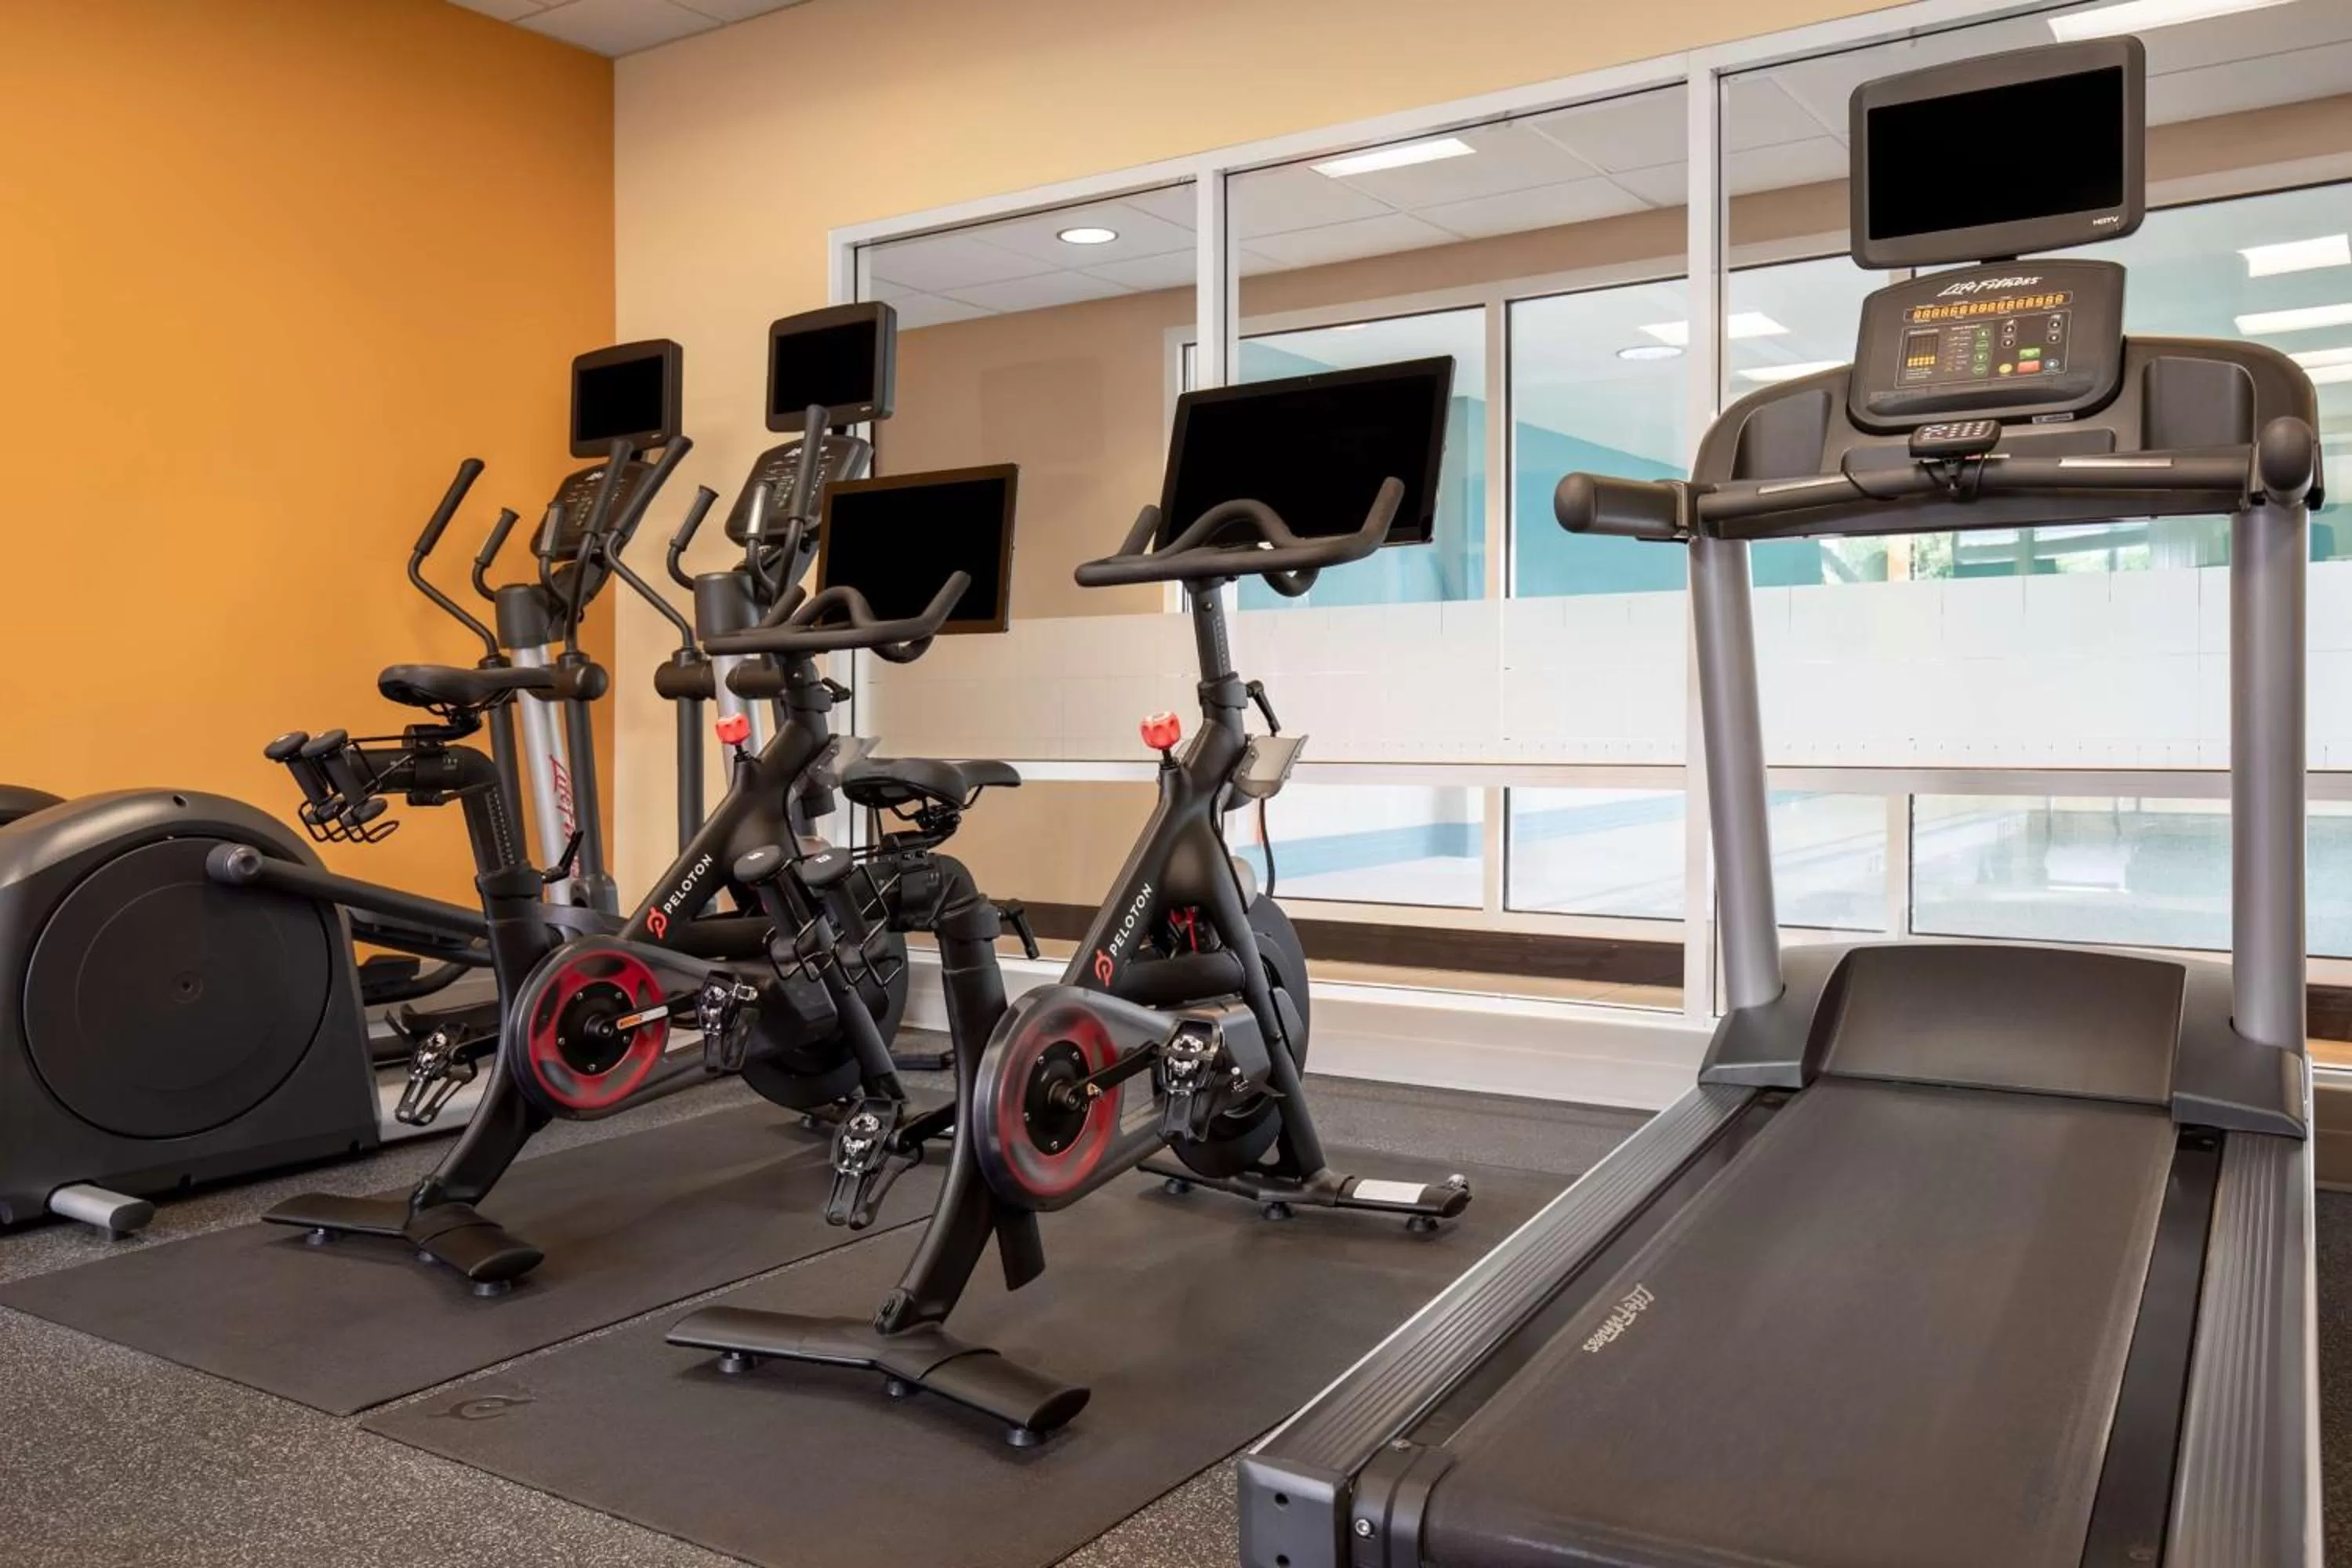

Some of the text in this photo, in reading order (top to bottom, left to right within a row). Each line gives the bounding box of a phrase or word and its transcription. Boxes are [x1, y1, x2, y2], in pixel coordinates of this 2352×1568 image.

[1936, 277, 2043, 297] Life Fitness
[663, 853, 713, 916] PELOTON
[1109, 883, 1152, 956] PELOTON
[1621, 1283, 1655, 1311] Life
